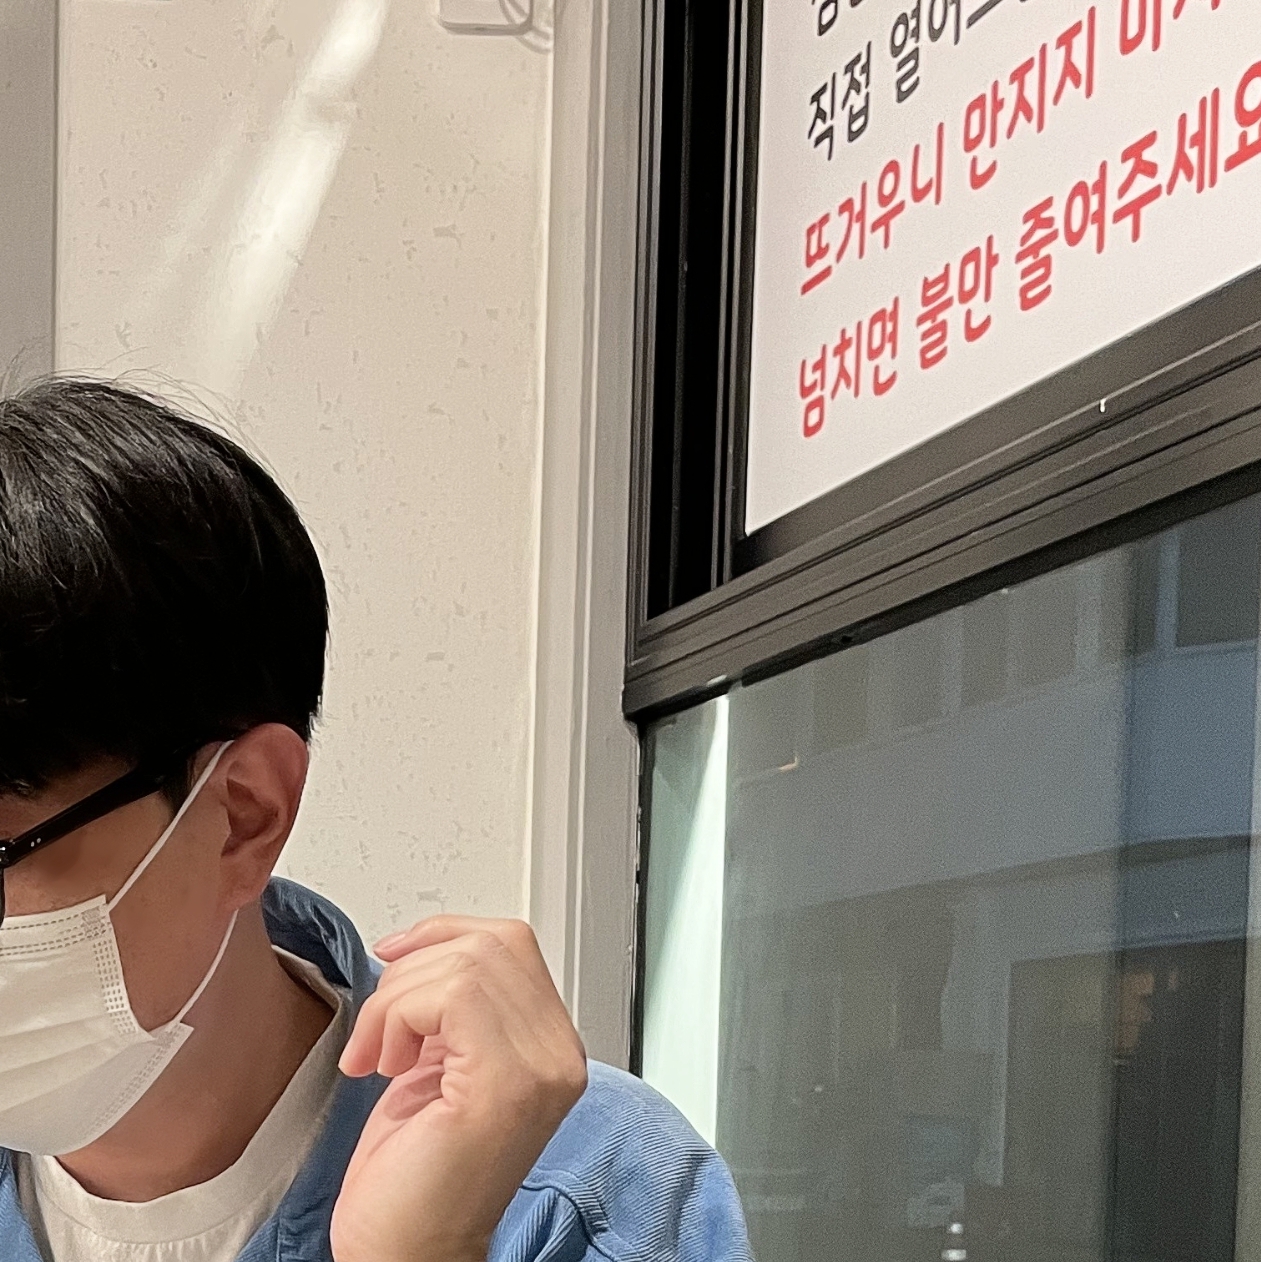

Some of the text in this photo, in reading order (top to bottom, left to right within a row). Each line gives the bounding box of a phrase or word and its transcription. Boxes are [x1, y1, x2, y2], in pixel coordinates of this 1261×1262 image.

[801, 121, 945, 296] 뜨거우니
[963, 6, 1096, 190] 만지지
[808, 0, 1004, 161] 직접 열어
[799, 60, 1261, 438] 넘치면 불만 줄여주세요
